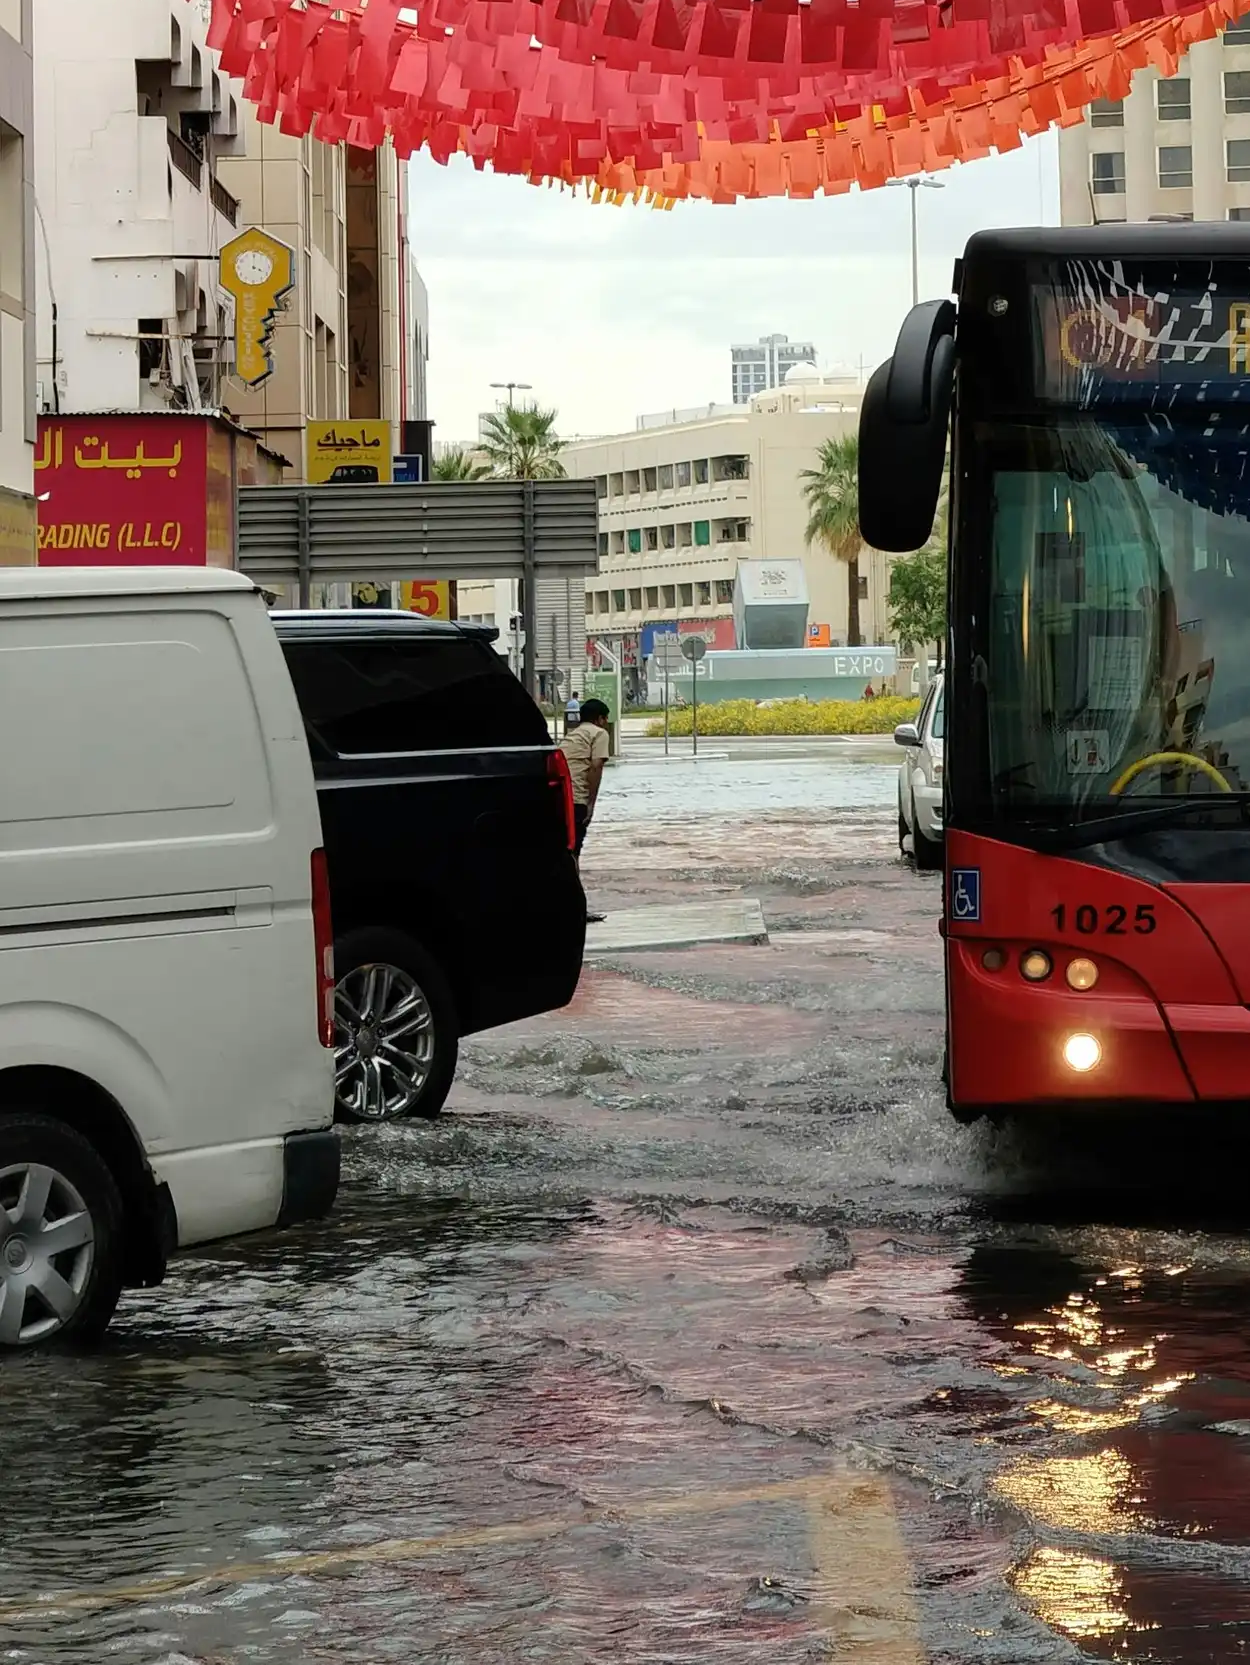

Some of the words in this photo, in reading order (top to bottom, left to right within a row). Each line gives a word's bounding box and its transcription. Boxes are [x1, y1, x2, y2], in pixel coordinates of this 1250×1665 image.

[317, 428, 380, 451] ماجيك
[75, 436, 182, 478] بيت
[37, 523, 110, 549] RADING
[118, 522, 181, 552] (L.L.C)
[410, 580, 439, 617] 5
[834, 656, 885, 675] EXPO
[1051, 904, 1158, 935] 1025
